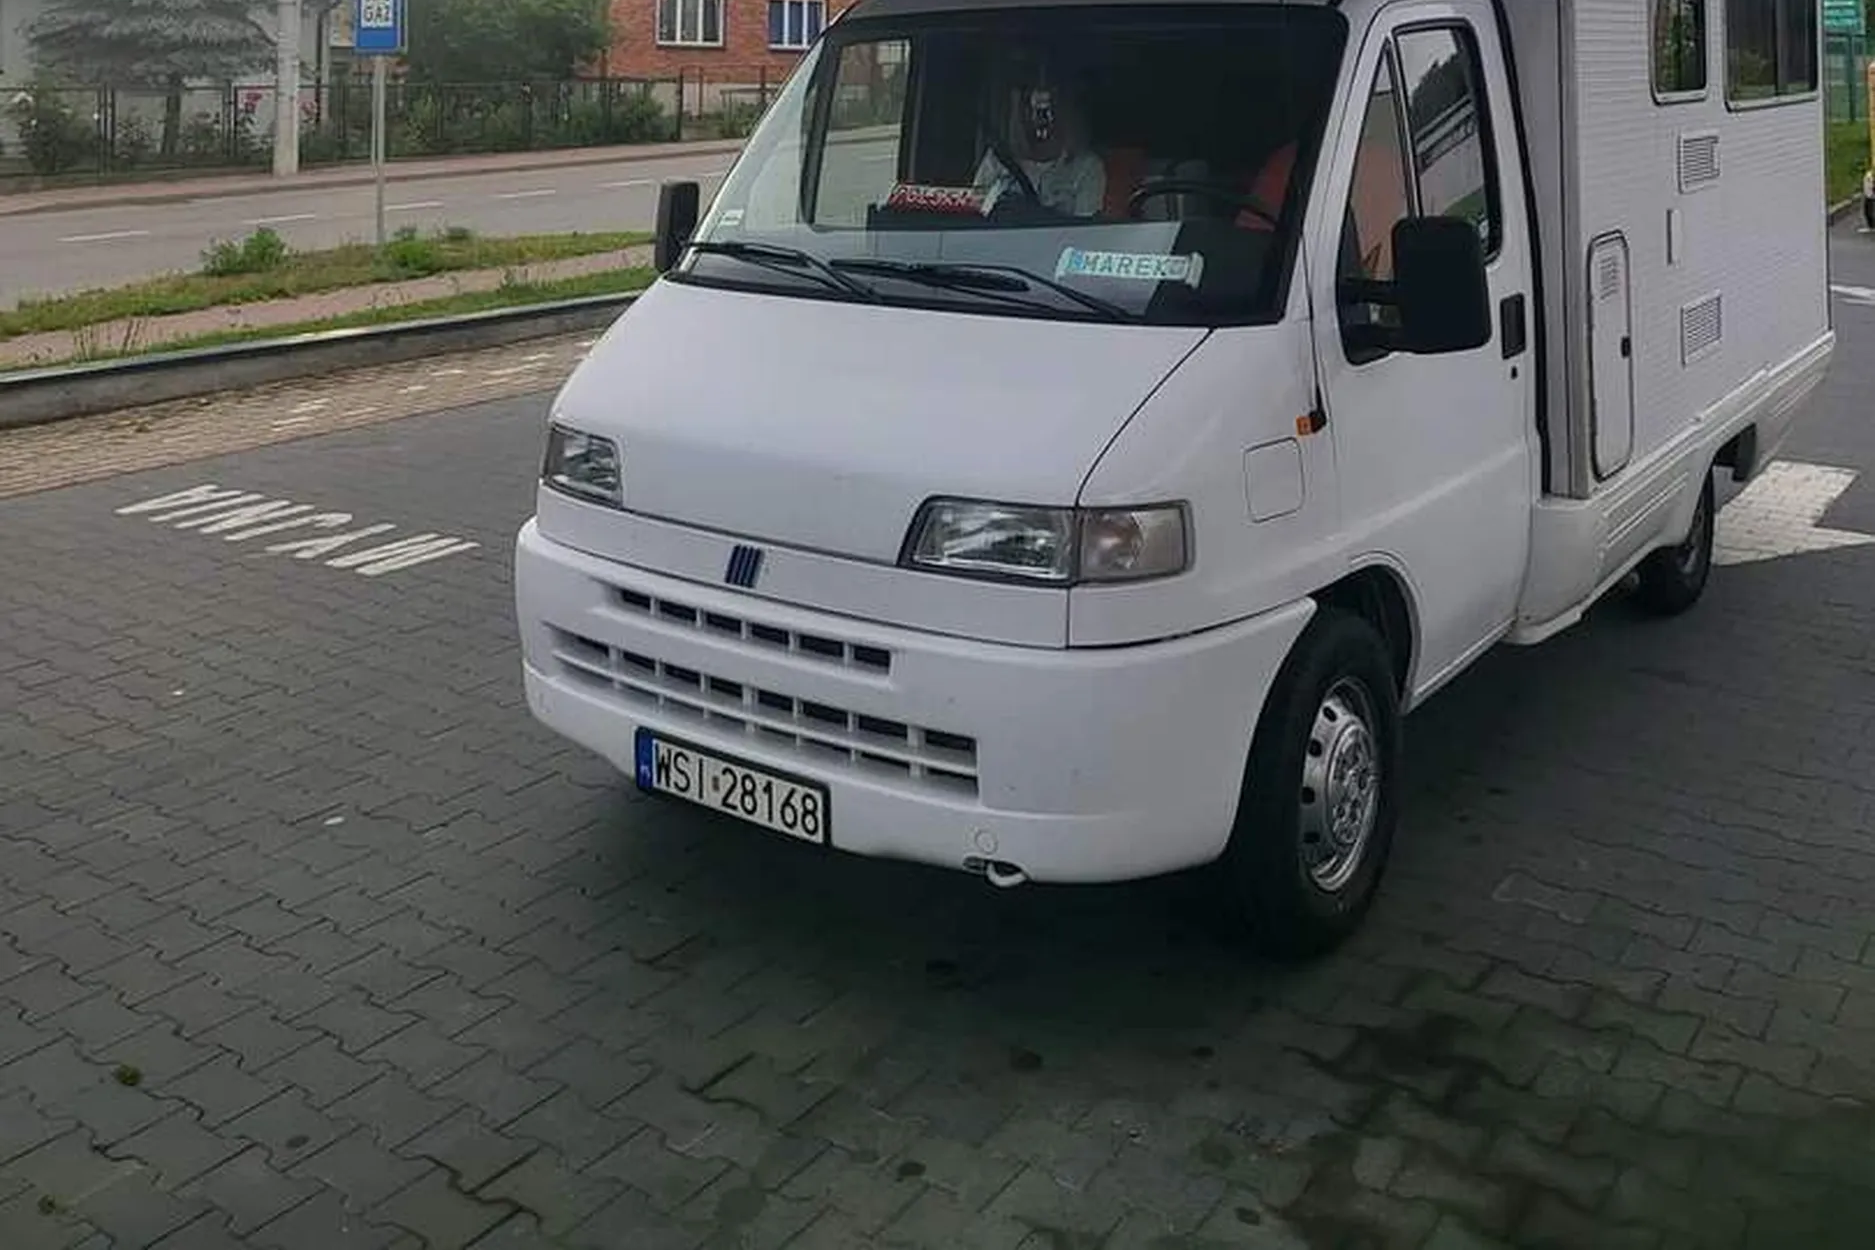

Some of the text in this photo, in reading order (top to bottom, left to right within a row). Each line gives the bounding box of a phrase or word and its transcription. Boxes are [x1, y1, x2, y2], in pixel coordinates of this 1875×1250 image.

[364, 5, 391, 23] GAZ
[1083, 253, 1170, 277] MAREK
[655, 742, 820, 836] WSI 28168
